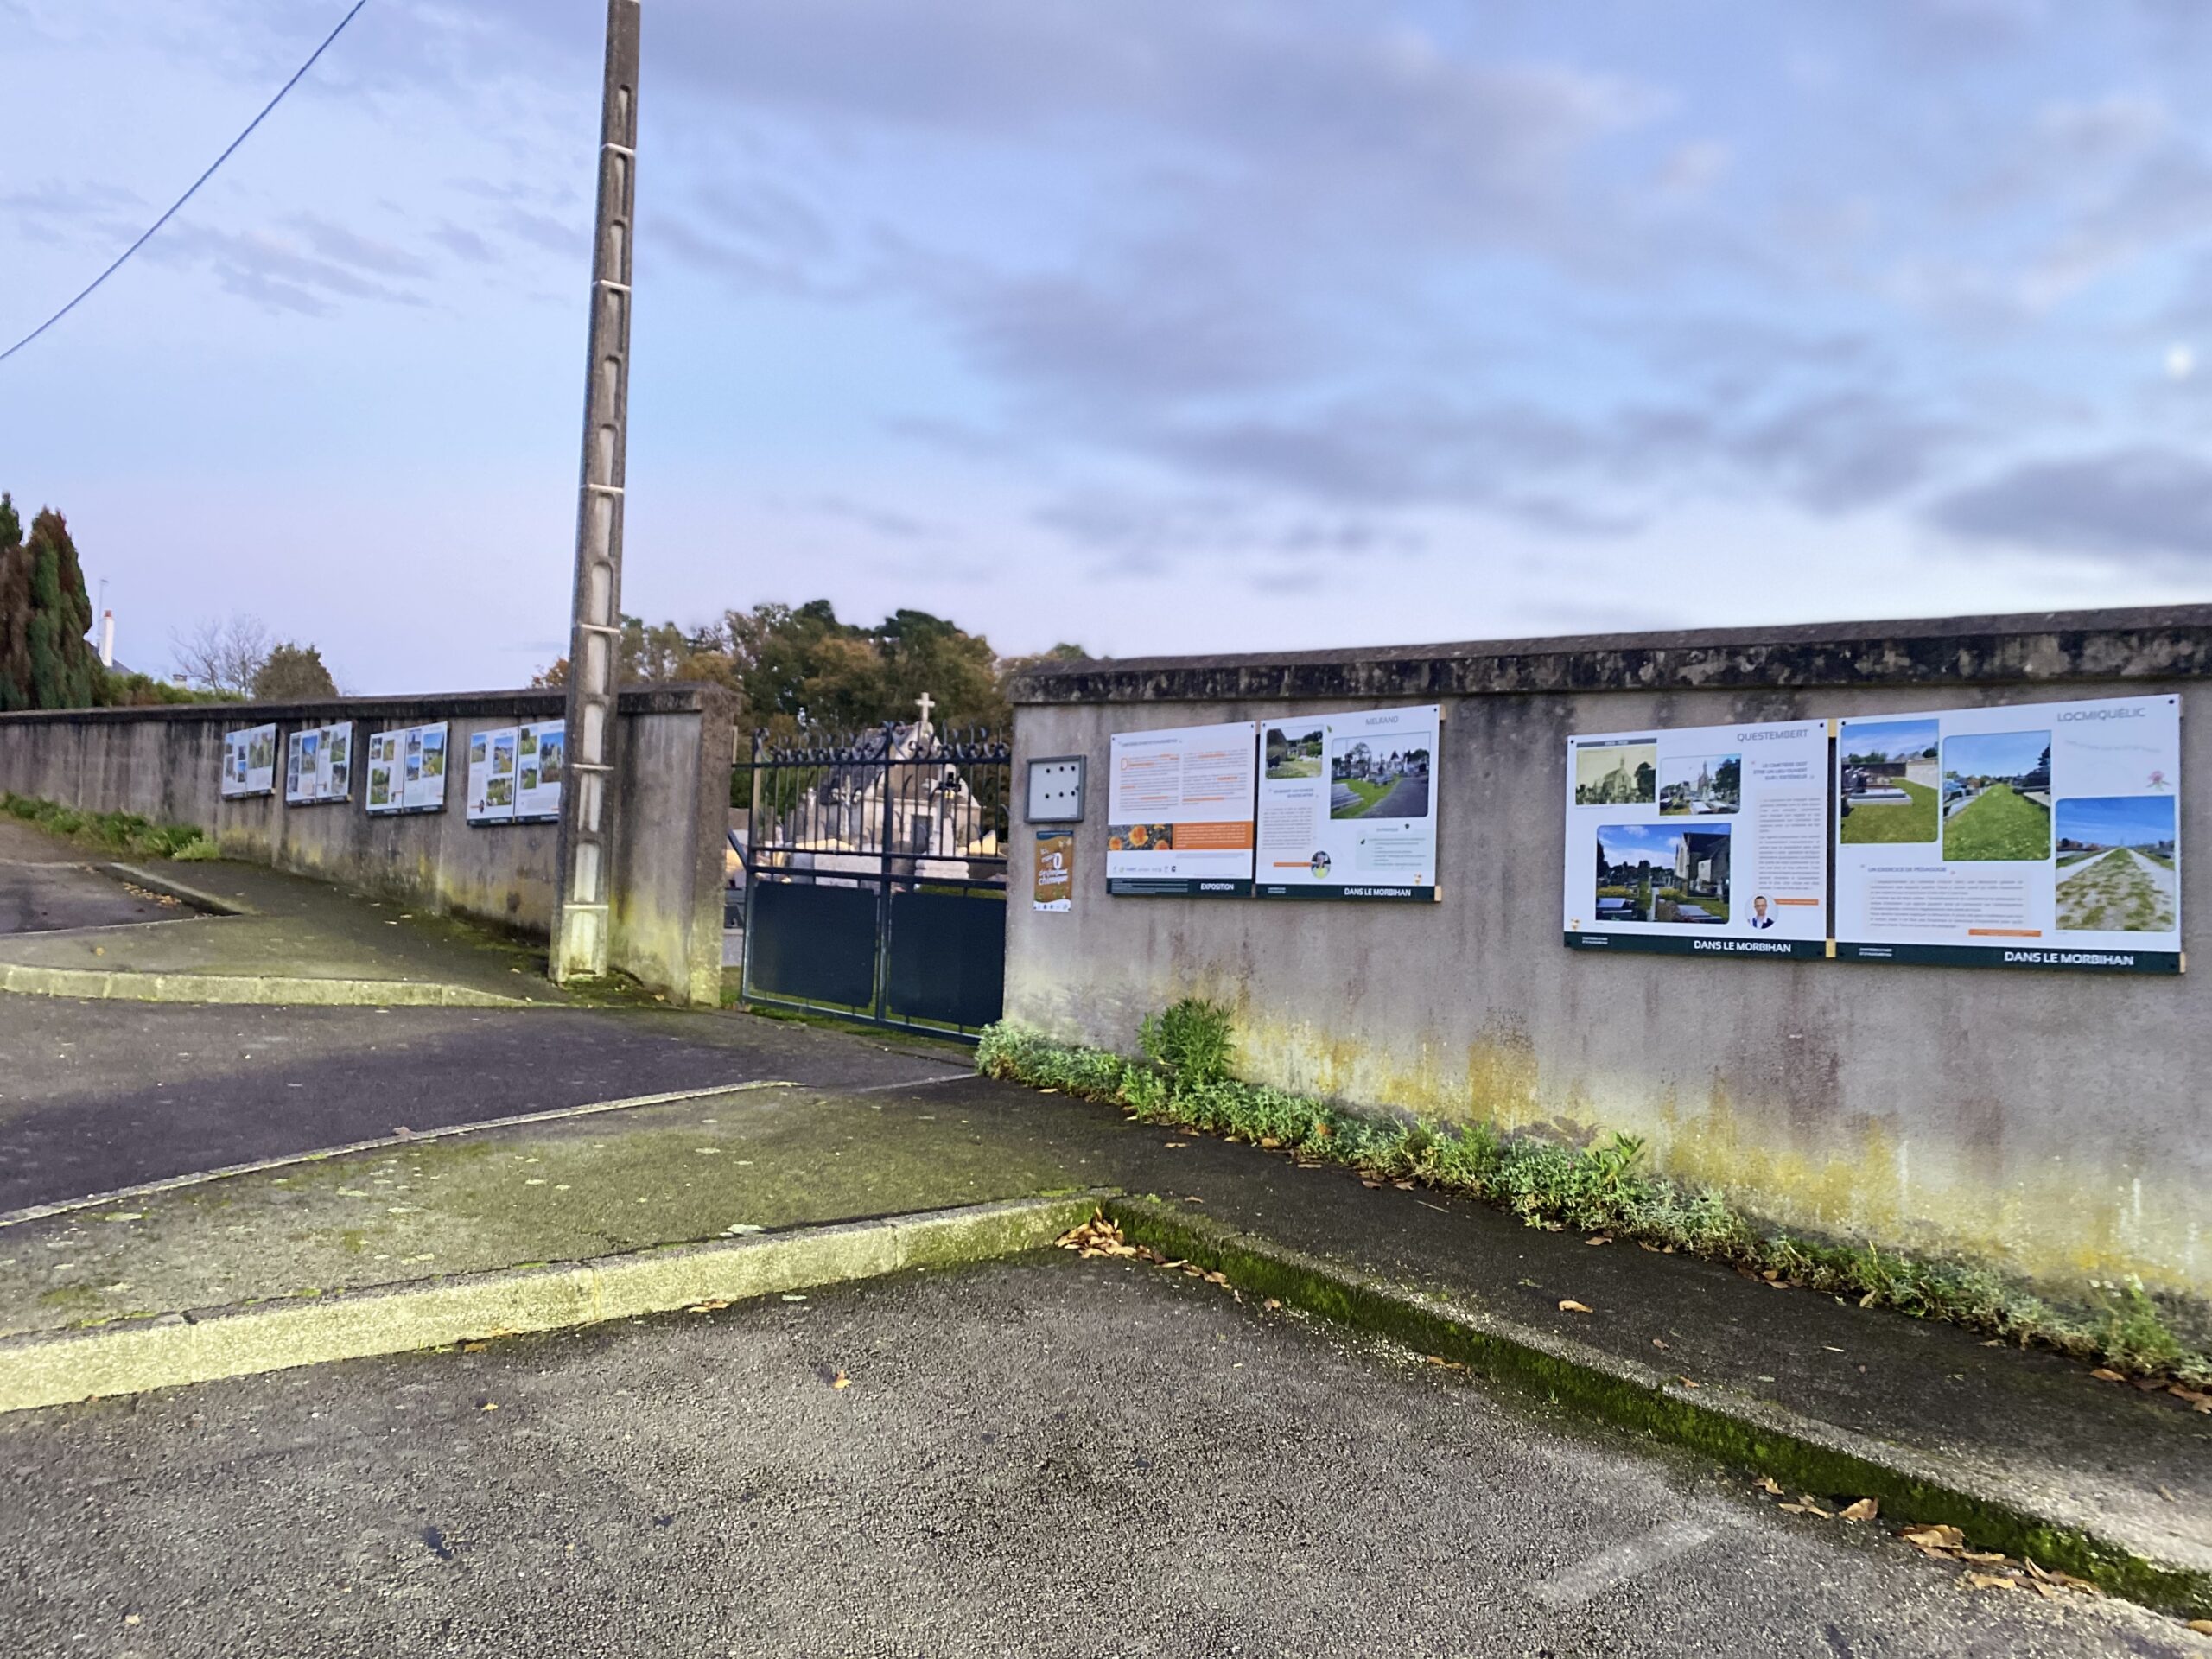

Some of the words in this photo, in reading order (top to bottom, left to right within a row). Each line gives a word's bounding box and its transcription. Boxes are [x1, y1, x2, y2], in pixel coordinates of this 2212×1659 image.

[1365, 715, 1399, 726] MELRAND
[2057, 707, 2145, 722] LOCMIQUÉLIC
[1737, 728, 1808, 743] QUESTEMBERT
[1200, 882, 1235, 891] EXPOSITION
[1344, 887, 1363, 895] DANS
[1373, 887, 1411, 897] MORBIHAN
[1694, 939, 1722, 950] DANS
[1723, 940, 1735, 950] LE
[1736, 941, 1791, 953] MORBIHAN
[2004, 950, 2041, 963] DANS
[2043, 952, 2059, 963] LE
[2060, 953, 2134, 966] MORBIHAN
